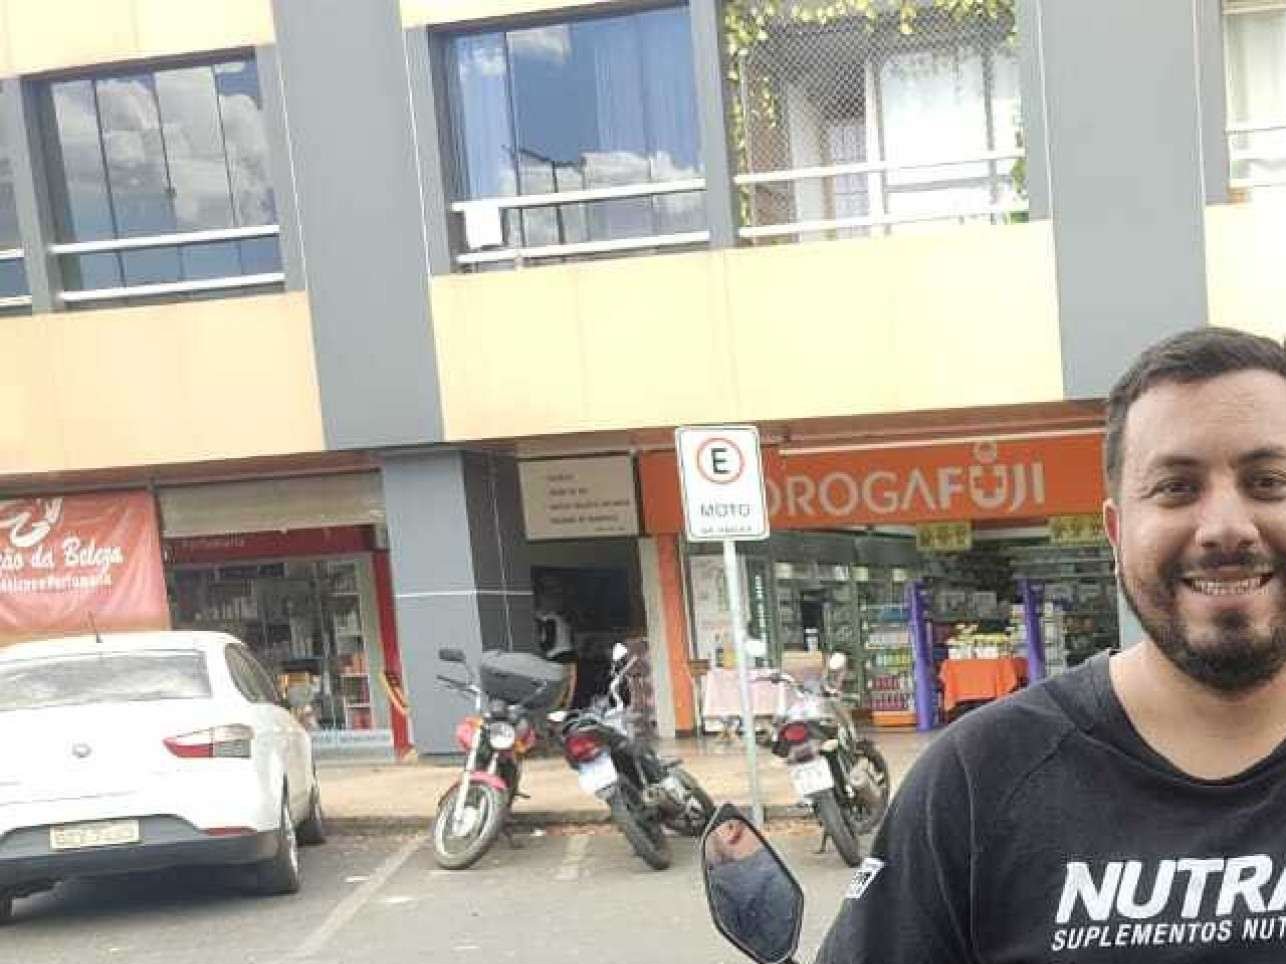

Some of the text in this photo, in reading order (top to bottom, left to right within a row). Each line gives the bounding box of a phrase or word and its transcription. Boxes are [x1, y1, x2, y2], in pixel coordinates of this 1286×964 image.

[711, 447, 730, 474] E
[63, 535, 124, 576] Beleza
[1051, 919, 1232, 952] SUPLEMENTOS
